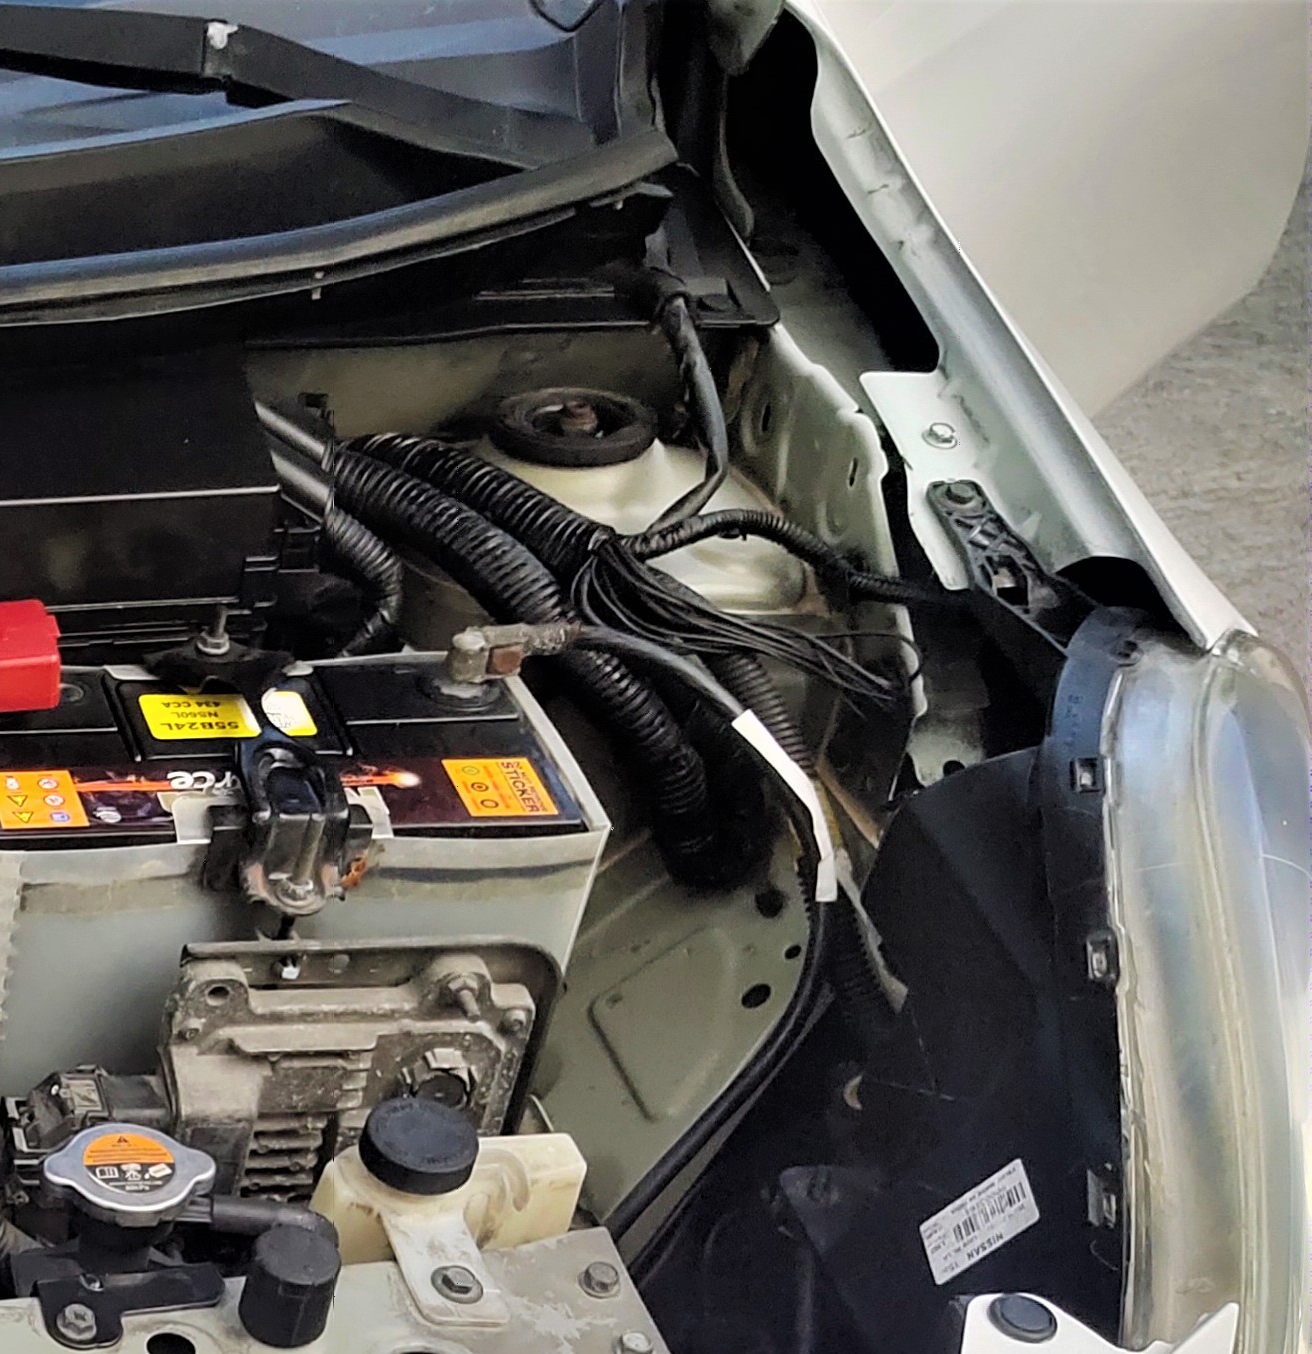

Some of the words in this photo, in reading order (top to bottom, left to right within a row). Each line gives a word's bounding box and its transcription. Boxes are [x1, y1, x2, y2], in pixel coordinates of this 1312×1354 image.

[161, 701, 193, 709] CCA
[160, 721, 240, 731] 55B24L
[500, 761, 541, 813] STICKER
